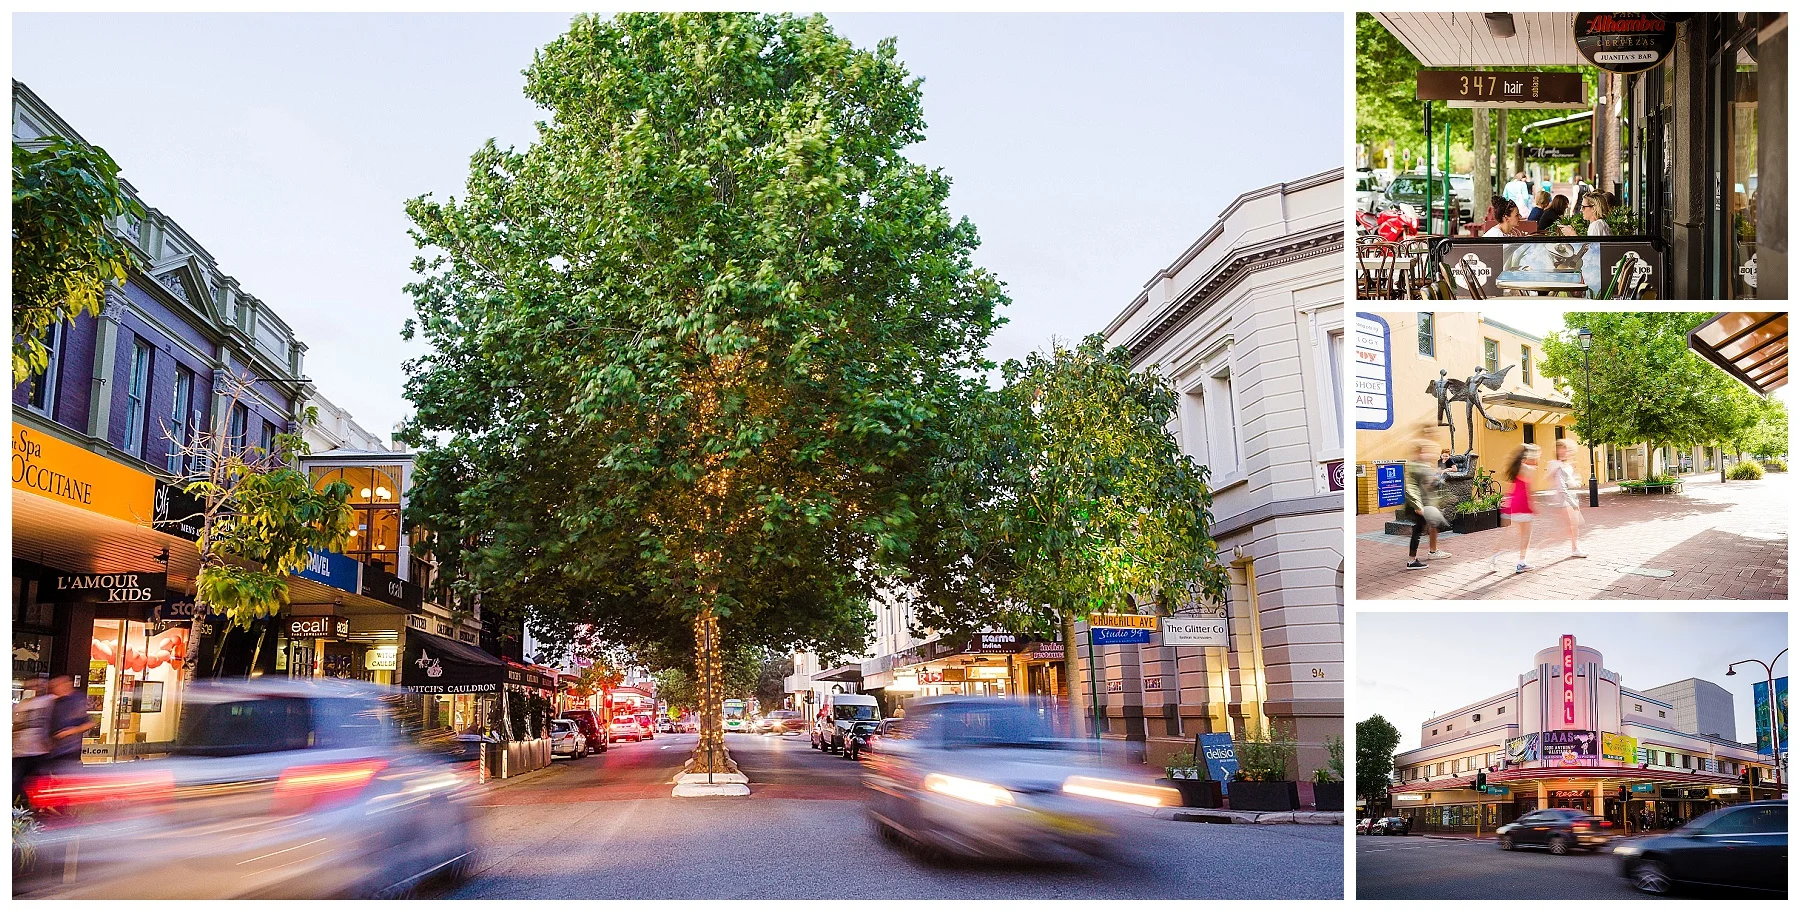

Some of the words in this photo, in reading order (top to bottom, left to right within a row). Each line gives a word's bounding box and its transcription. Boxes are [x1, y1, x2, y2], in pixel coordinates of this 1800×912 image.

[1586, 13, 1665, 34] Alhambra
[1597, 39, 1655, 47] CERVEZAS
[1504, 80, 1524, 94] hair
[1478, 268, 1490, 276] JOB
[1639, 266, 1651, 274] JOB
[18, 429, 41, 462] Spa
[12, 453, 92, 505] OCCITANE
[305, 550, 331, 577] RAVEL
[57, 574, 139, 590] L'AMOUR
[108, 587, 152, 602] KIDS
[291, 617, 329, 633] ecali
[1140, 616, 1153, 628] AVE
[1099, 628, 1129, 639] Studio
[1131, 628, 1143, 638] 94
[1167, 624, 1182, 633] The
[1184, 624, 1210, 633] Glitter
[1212, 625, 1224, 633] Co
[982, 634, 1016, 643] karma
[1311, 668, 1325, 679] 94
[1564, 637, 1573, 721] REGAL
[407, 685, 444, 693] WITCH'S
[447, 683, 496, 693] CAULDRON
[1544, 732, 1574, 743] DAAS
[1206, 748, 1234, 760] delisio
[1555, 790, 1585, 798] Regal
